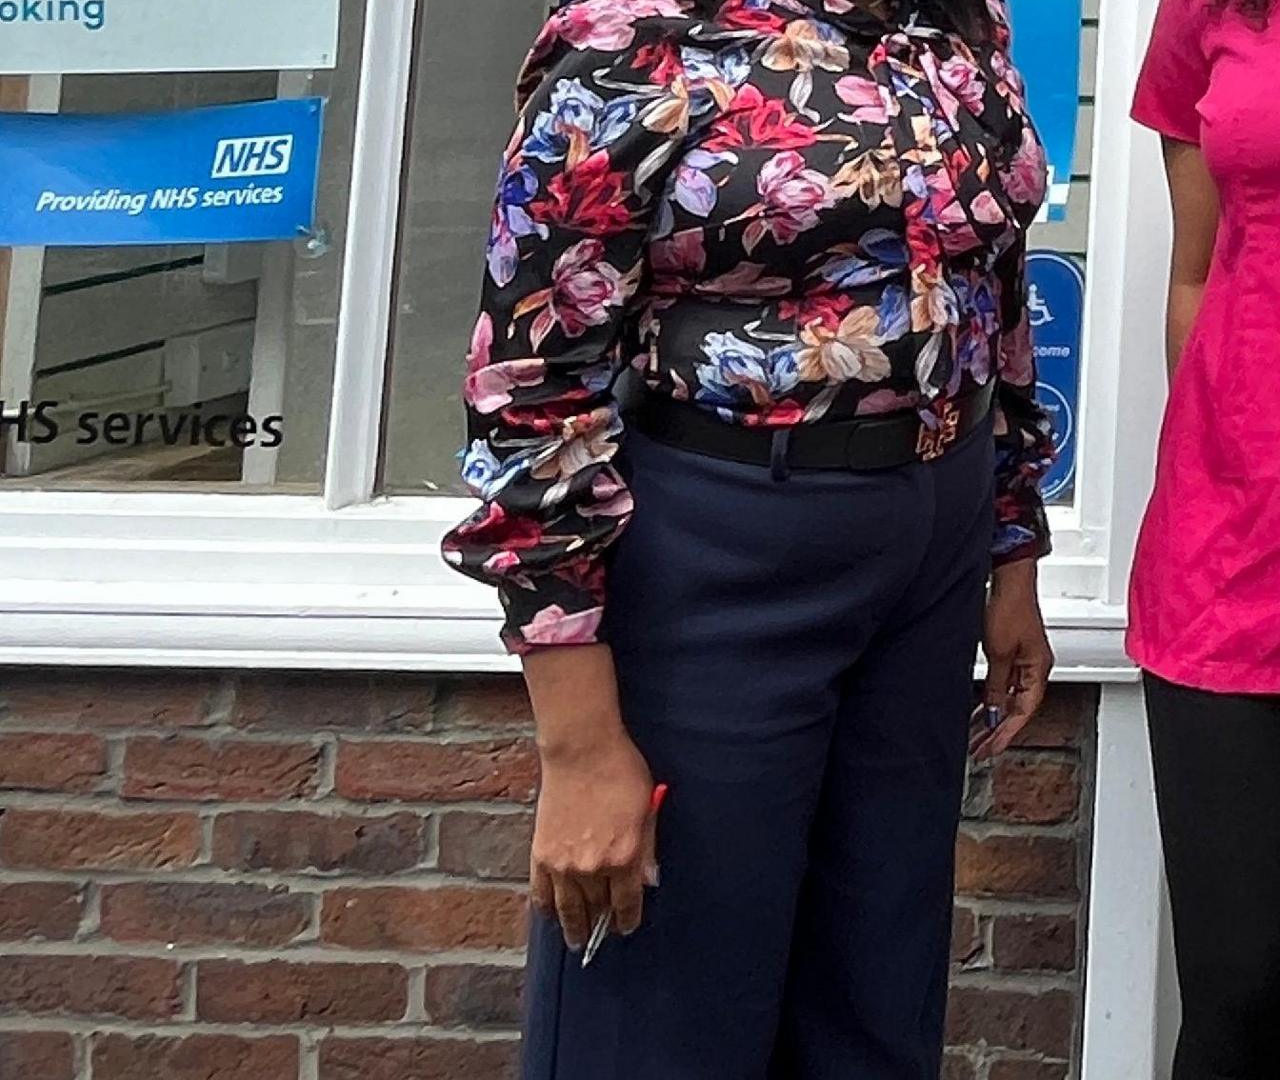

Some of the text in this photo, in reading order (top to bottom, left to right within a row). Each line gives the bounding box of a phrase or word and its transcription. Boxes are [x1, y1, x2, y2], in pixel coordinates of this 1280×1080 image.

[215, 138, 289, 174] NHS
[35, 182, 284, 216] Providing NHS services
[76, 407, 284, 449] services
